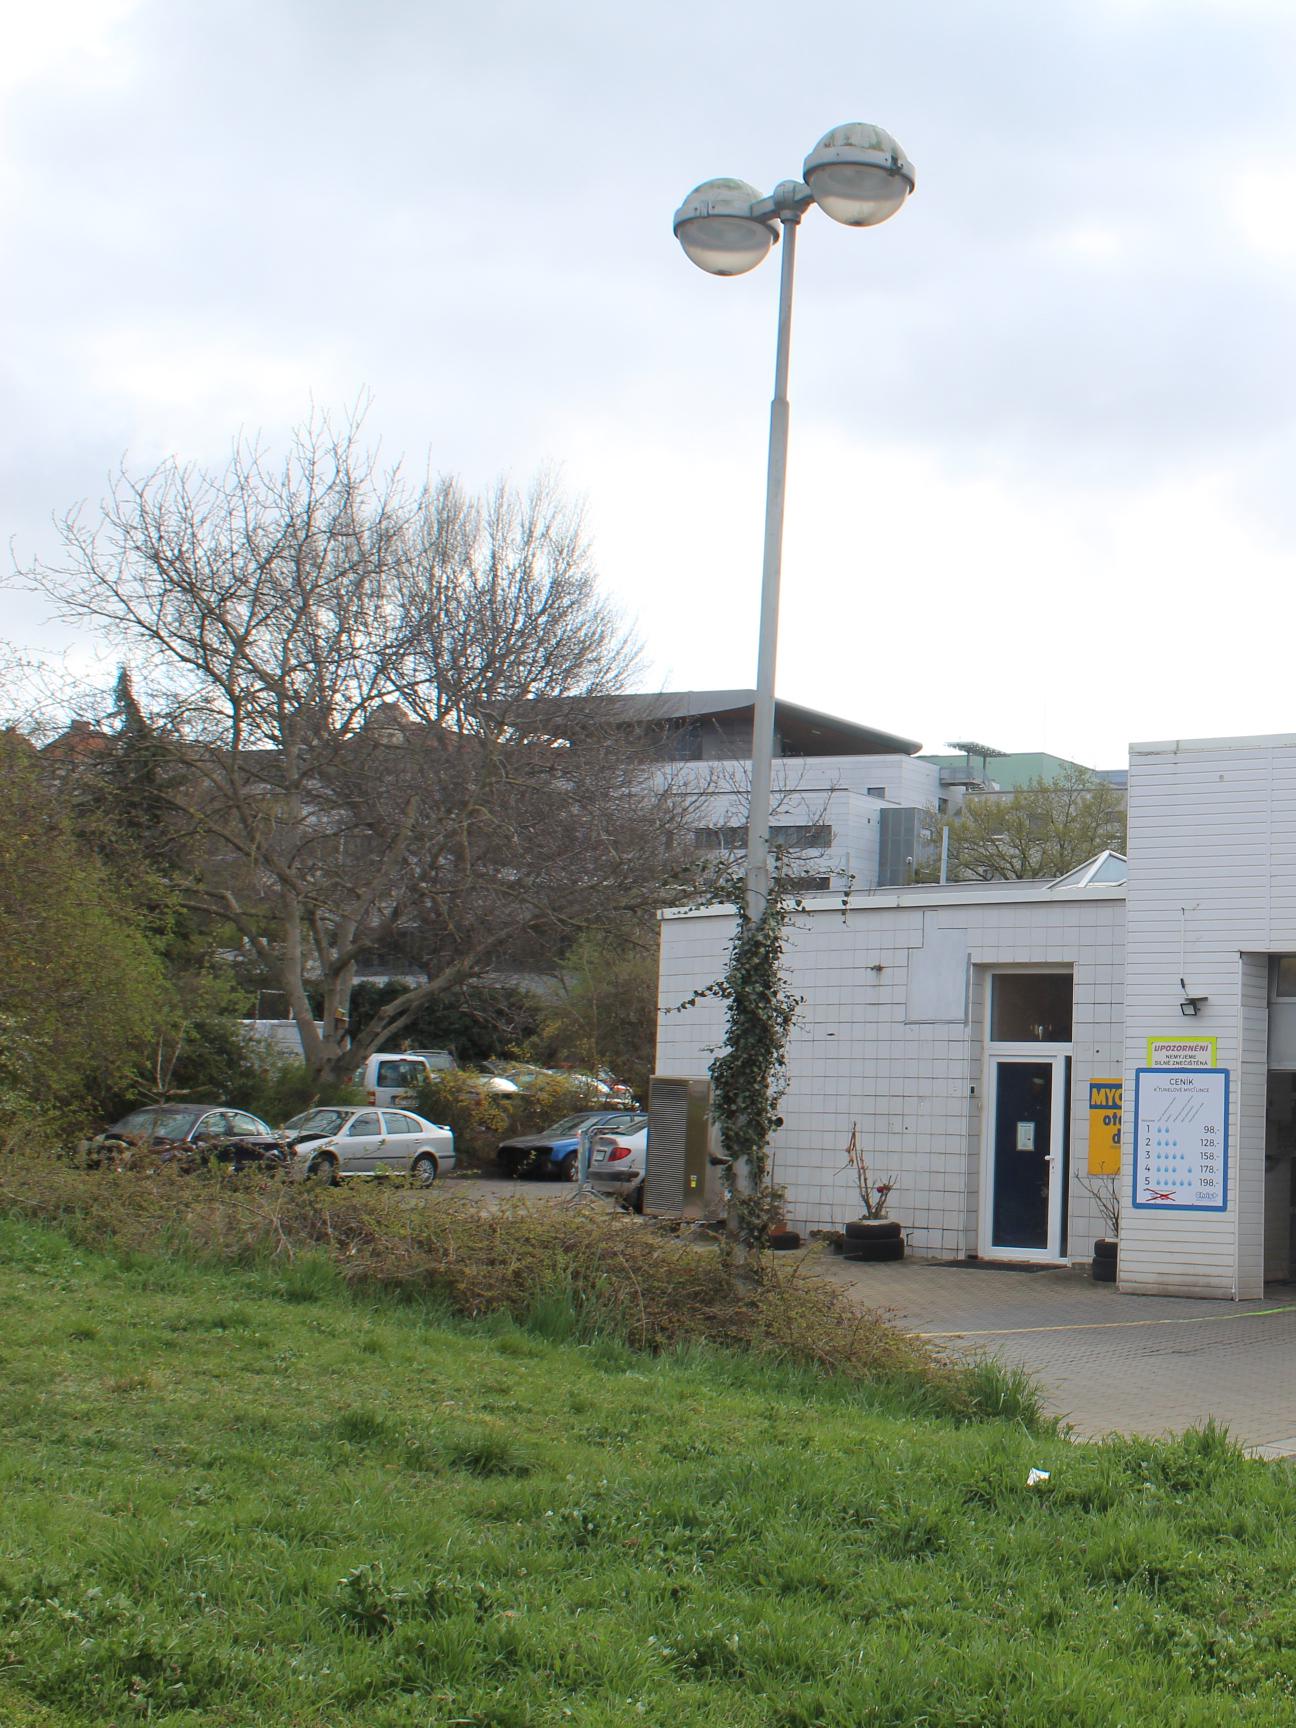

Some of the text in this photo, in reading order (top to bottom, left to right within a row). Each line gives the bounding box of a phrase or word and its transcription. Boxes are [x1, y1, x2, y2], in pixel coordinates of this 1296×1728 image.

[1169, 1076, 1194, 1086] CENÍK
[1146, 1124, 1150, 1133] 1
[1145, 1137, 1151, 1147] 2
[1145, 1150, 1151, 1160] 3
[1144, 1164, 1151, 1172] 4
[1144, 1176, 1150, 1186] 5
